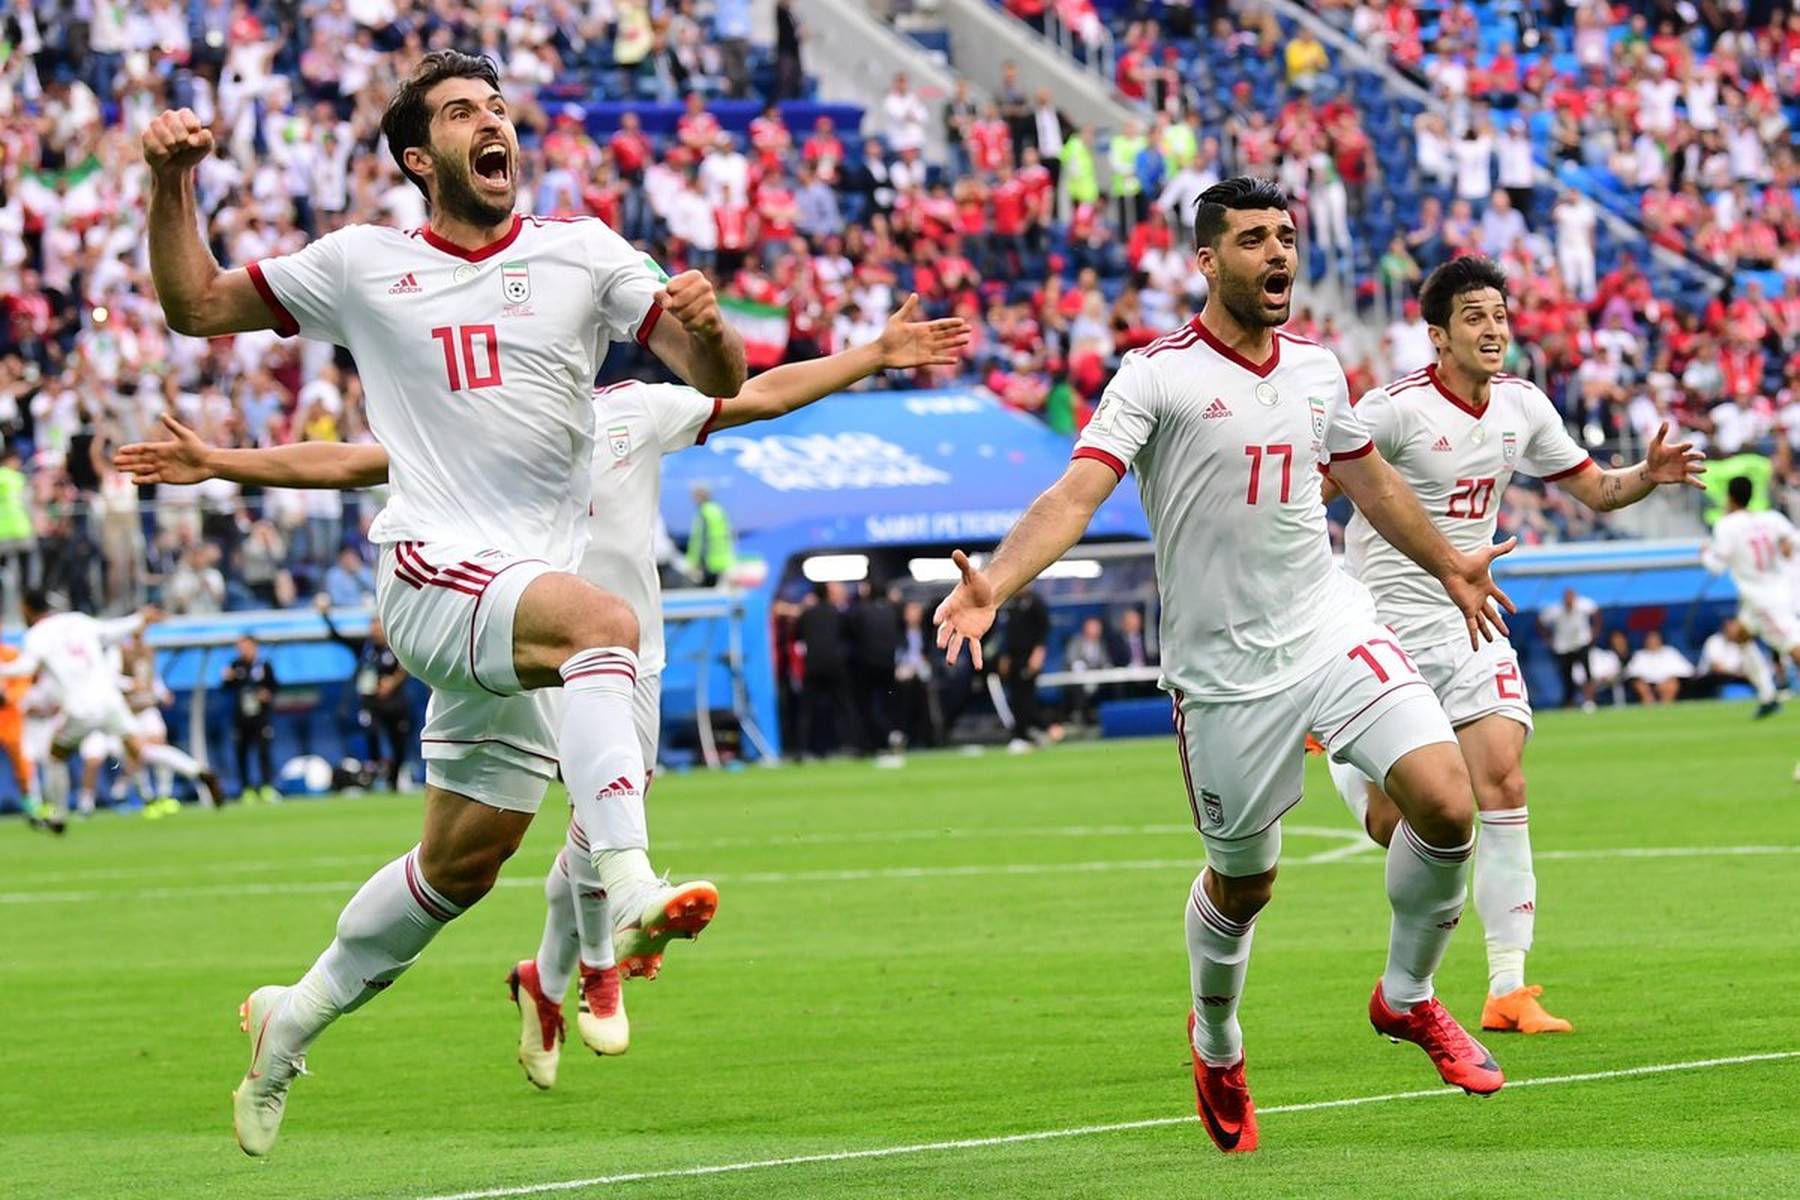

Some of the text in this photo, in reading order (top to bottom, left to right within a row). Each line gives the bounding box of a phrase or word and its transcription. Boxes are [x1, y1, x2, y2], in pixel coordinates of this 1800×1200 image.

[388, 285, 423, 295] adidas
[431, 324, 503, 392] 10
[1202, 409, 1233, 420] adidas
[1245, 444, 1292, 505] 17
[1445, 477, 1497, 519] 20
[1495, 659, 1528, 702] 2
